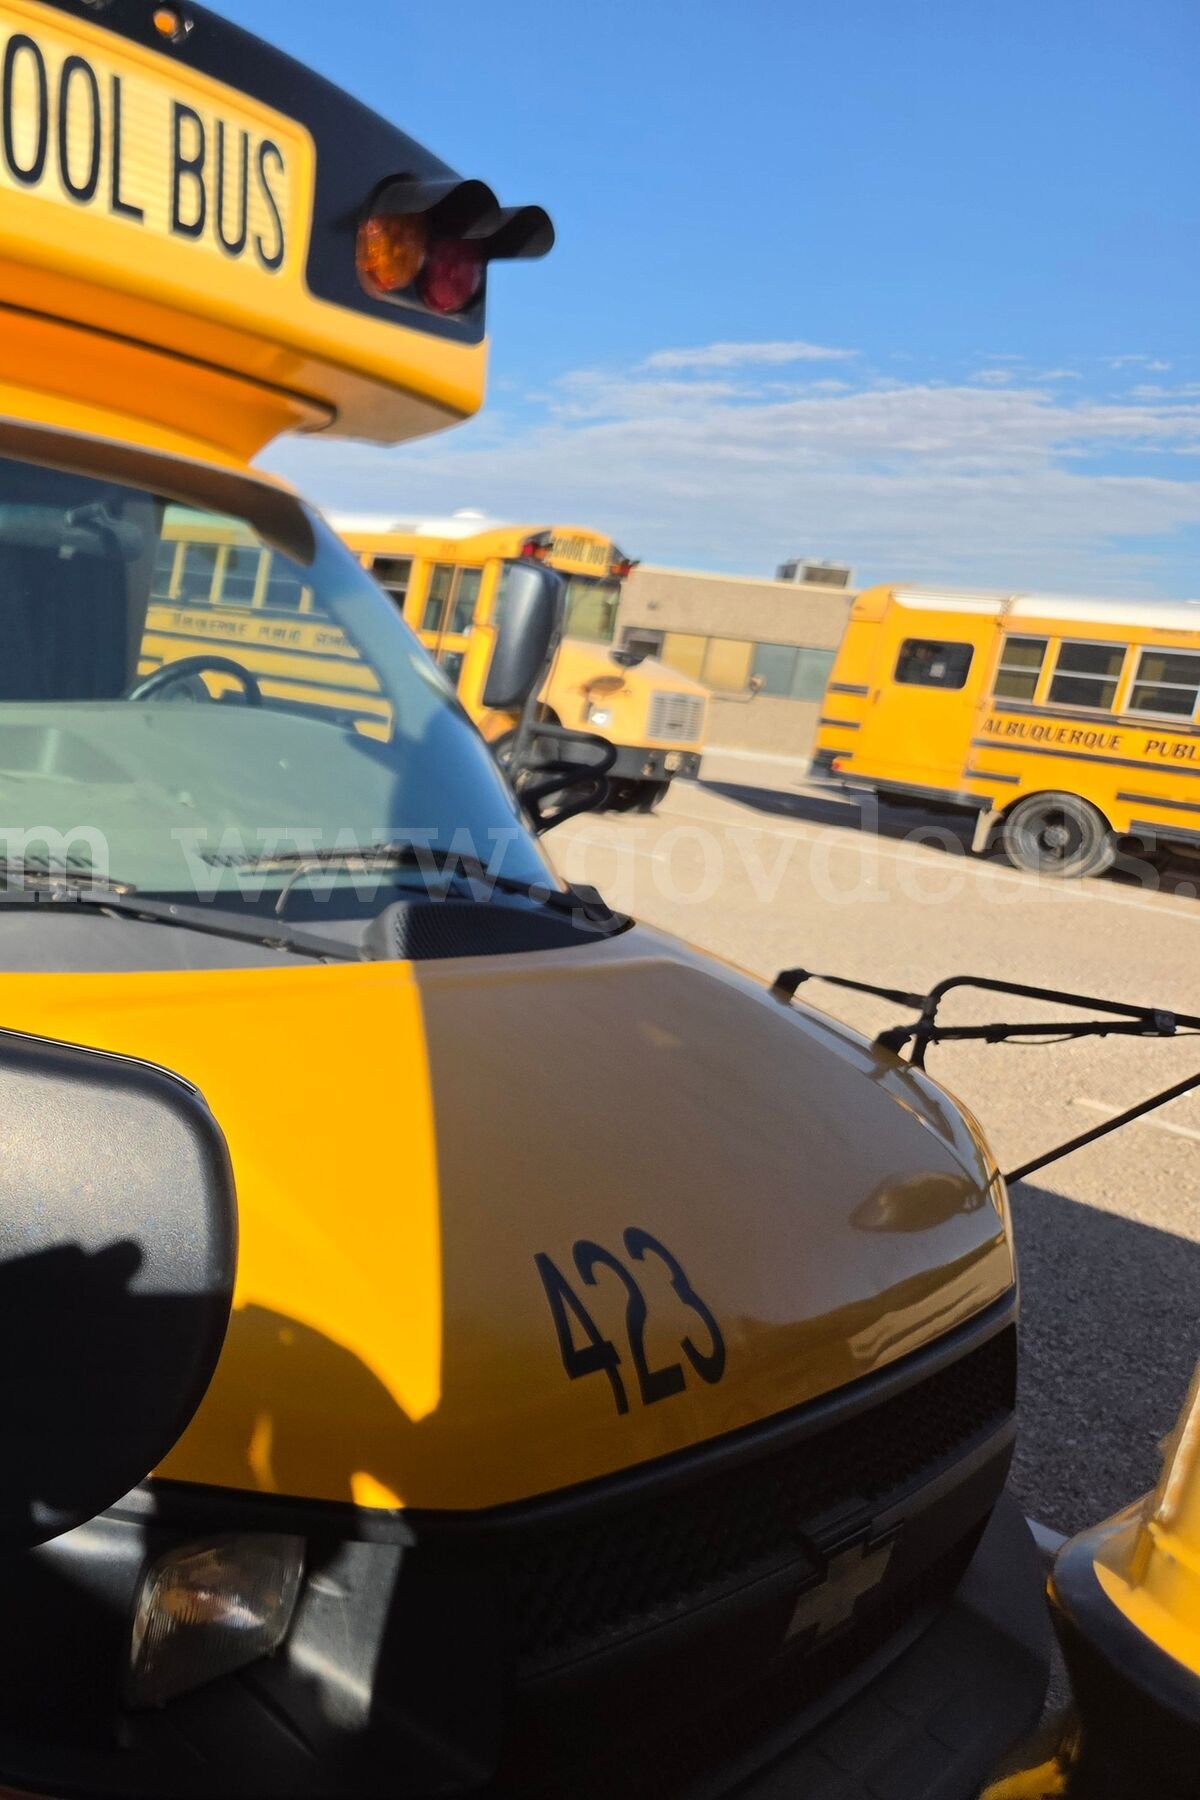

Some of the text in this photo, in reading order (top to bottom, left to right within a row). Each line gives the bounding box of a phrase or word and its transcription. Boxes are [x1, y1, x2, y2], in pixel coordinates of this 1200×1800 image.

[169, 100, 286, 271] BUS
[982, 719, 1123, 750] ALBUQUERQUE
[533, 1226, 726, 1416] 423
